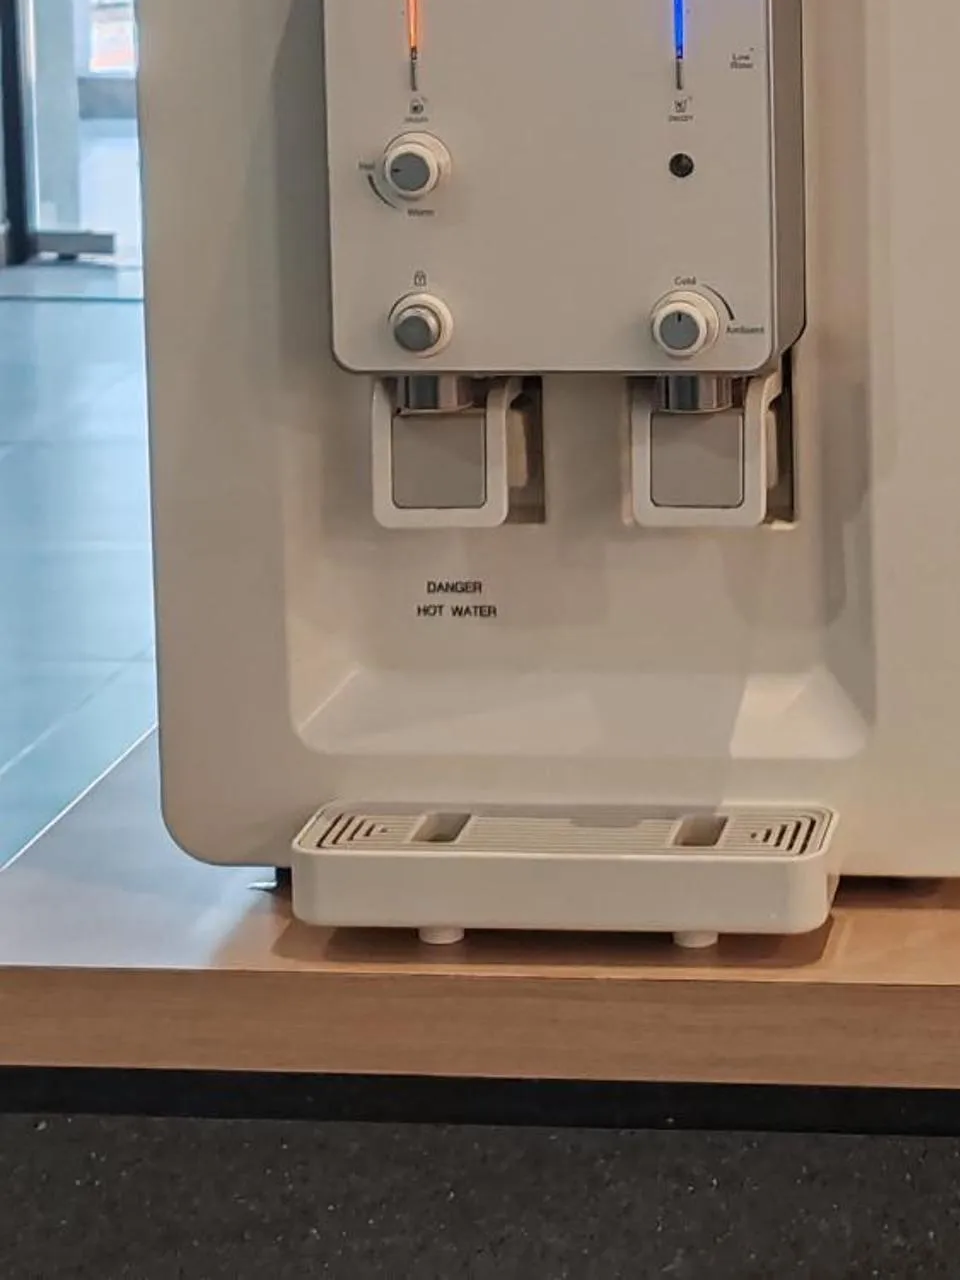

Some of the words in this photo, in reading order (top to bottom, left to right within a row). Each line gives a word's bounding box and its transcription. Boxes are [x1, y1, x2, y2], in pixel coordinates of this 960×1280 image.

[426, 580, 482, 594] DANGER
[416, 604, 445, 617] HOT
[450, 604, 498, 618] WATER
